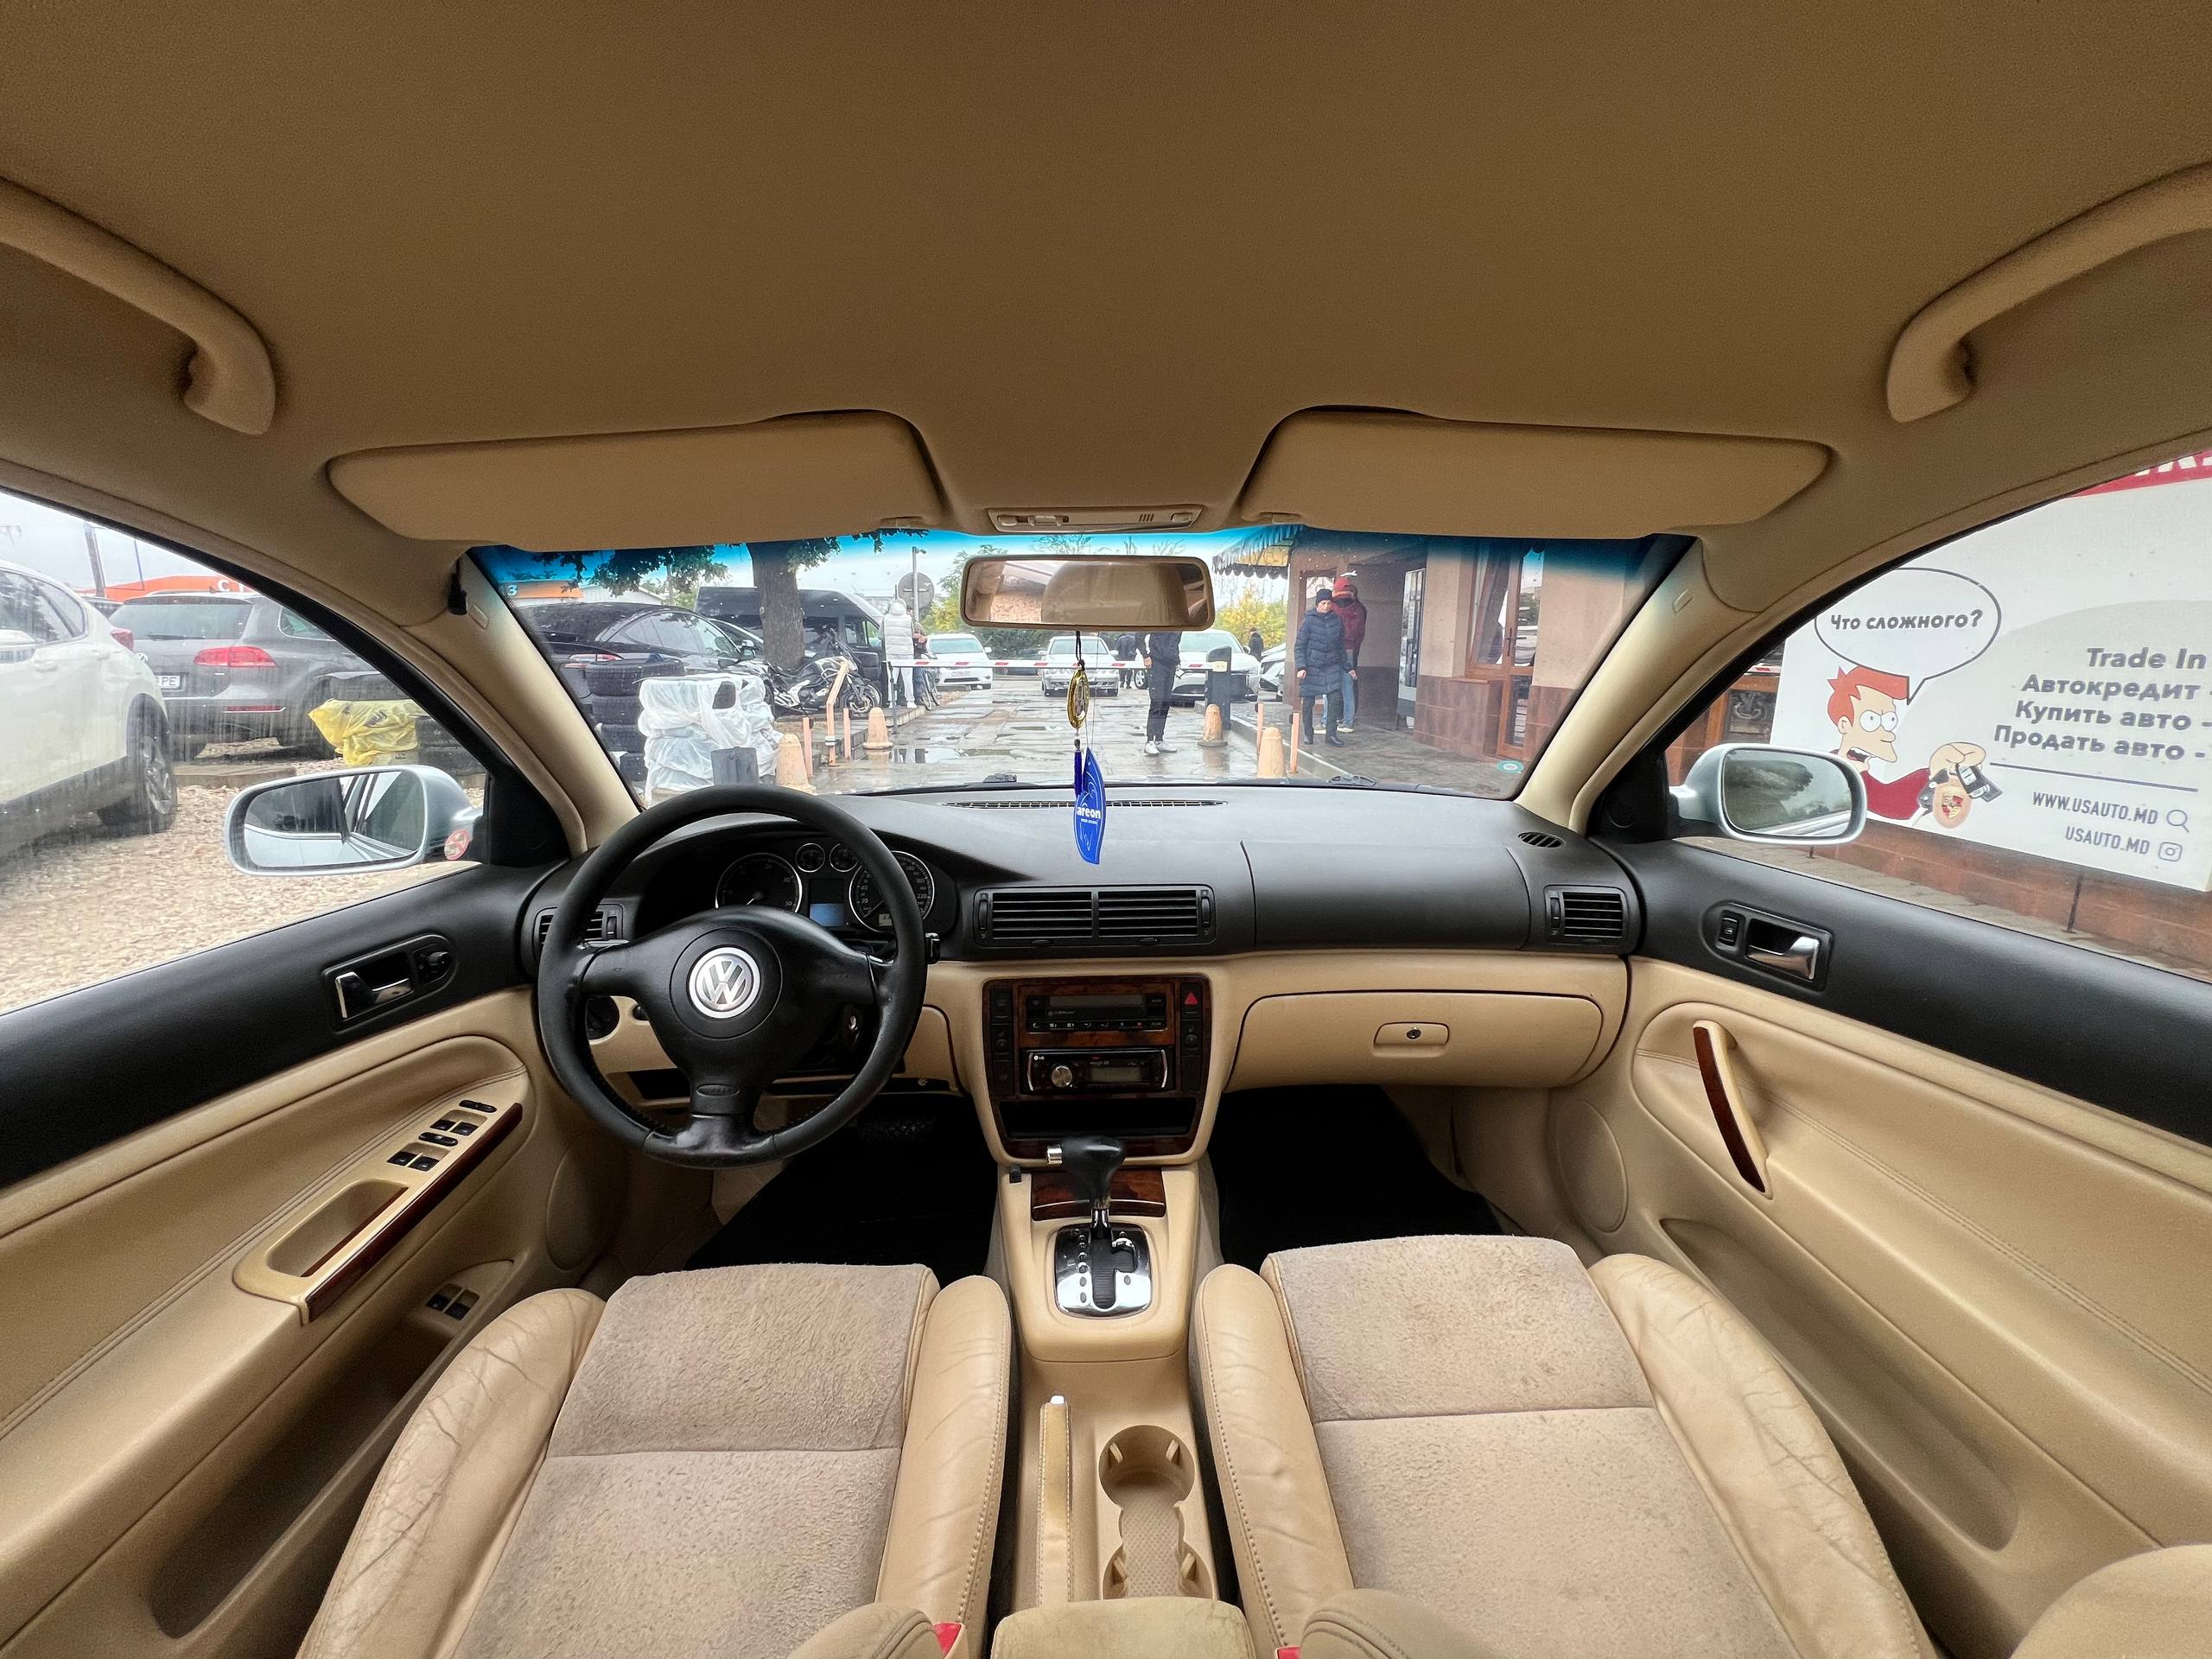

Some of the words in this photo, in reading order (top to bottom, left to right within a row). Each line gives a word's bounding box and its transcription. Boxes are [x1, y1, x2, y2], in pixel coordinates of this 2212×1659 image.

[1831, 614, 1860, 630] Что
[1866, 608, 1983, 630] сложного?
[2087, 646, 2166, 669] Trade
[2176, 648, 2207, 669] In
[2021, 674, 2201, 702] Автокредит
[2015, 700, 2112, 725] Купить
[2120, 711, 2191, 731] авто
[1993, 724, 2105, 753] Продать
[2113, 740, 2184, 760] авто
[1077, 805, 1102, 819] areon
[2032, 791, 2158, 824] WWW.USAUTO.MD
[2065, 825, 2151, 855] USAUTO.MD
